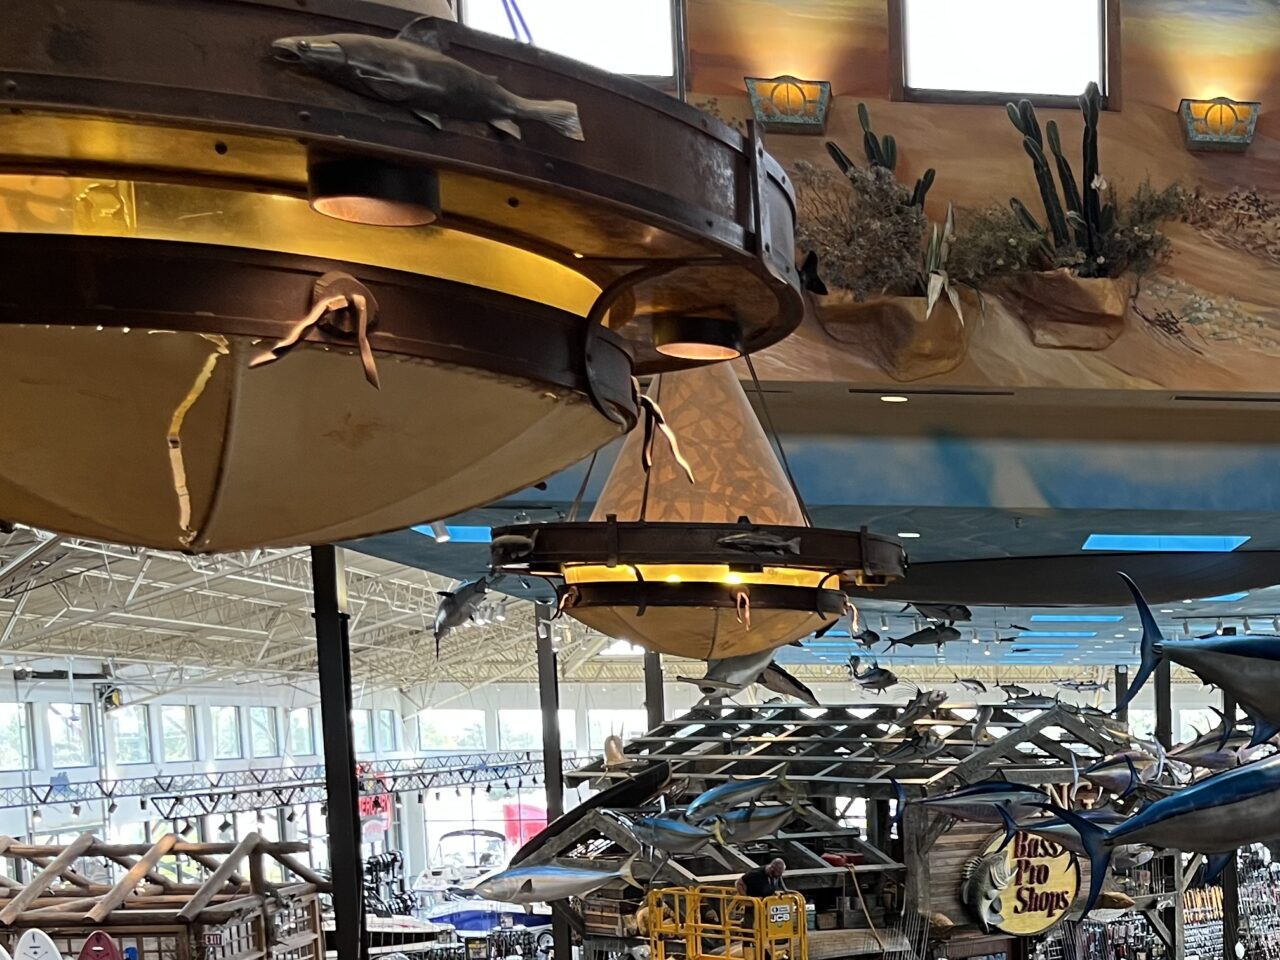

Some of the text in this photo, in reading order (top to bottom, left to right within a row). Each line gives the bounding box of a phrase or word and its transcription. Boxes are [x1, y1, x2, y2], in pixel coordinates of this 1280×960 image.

[1013, 831, 1060, 859] Bass
[1014, 859, 1050, 886] Pro
[1013, 886, 1070, 918] Shops
[769, 913, 791, 923] JCB
[205, 934, 221, 945] EXIT
